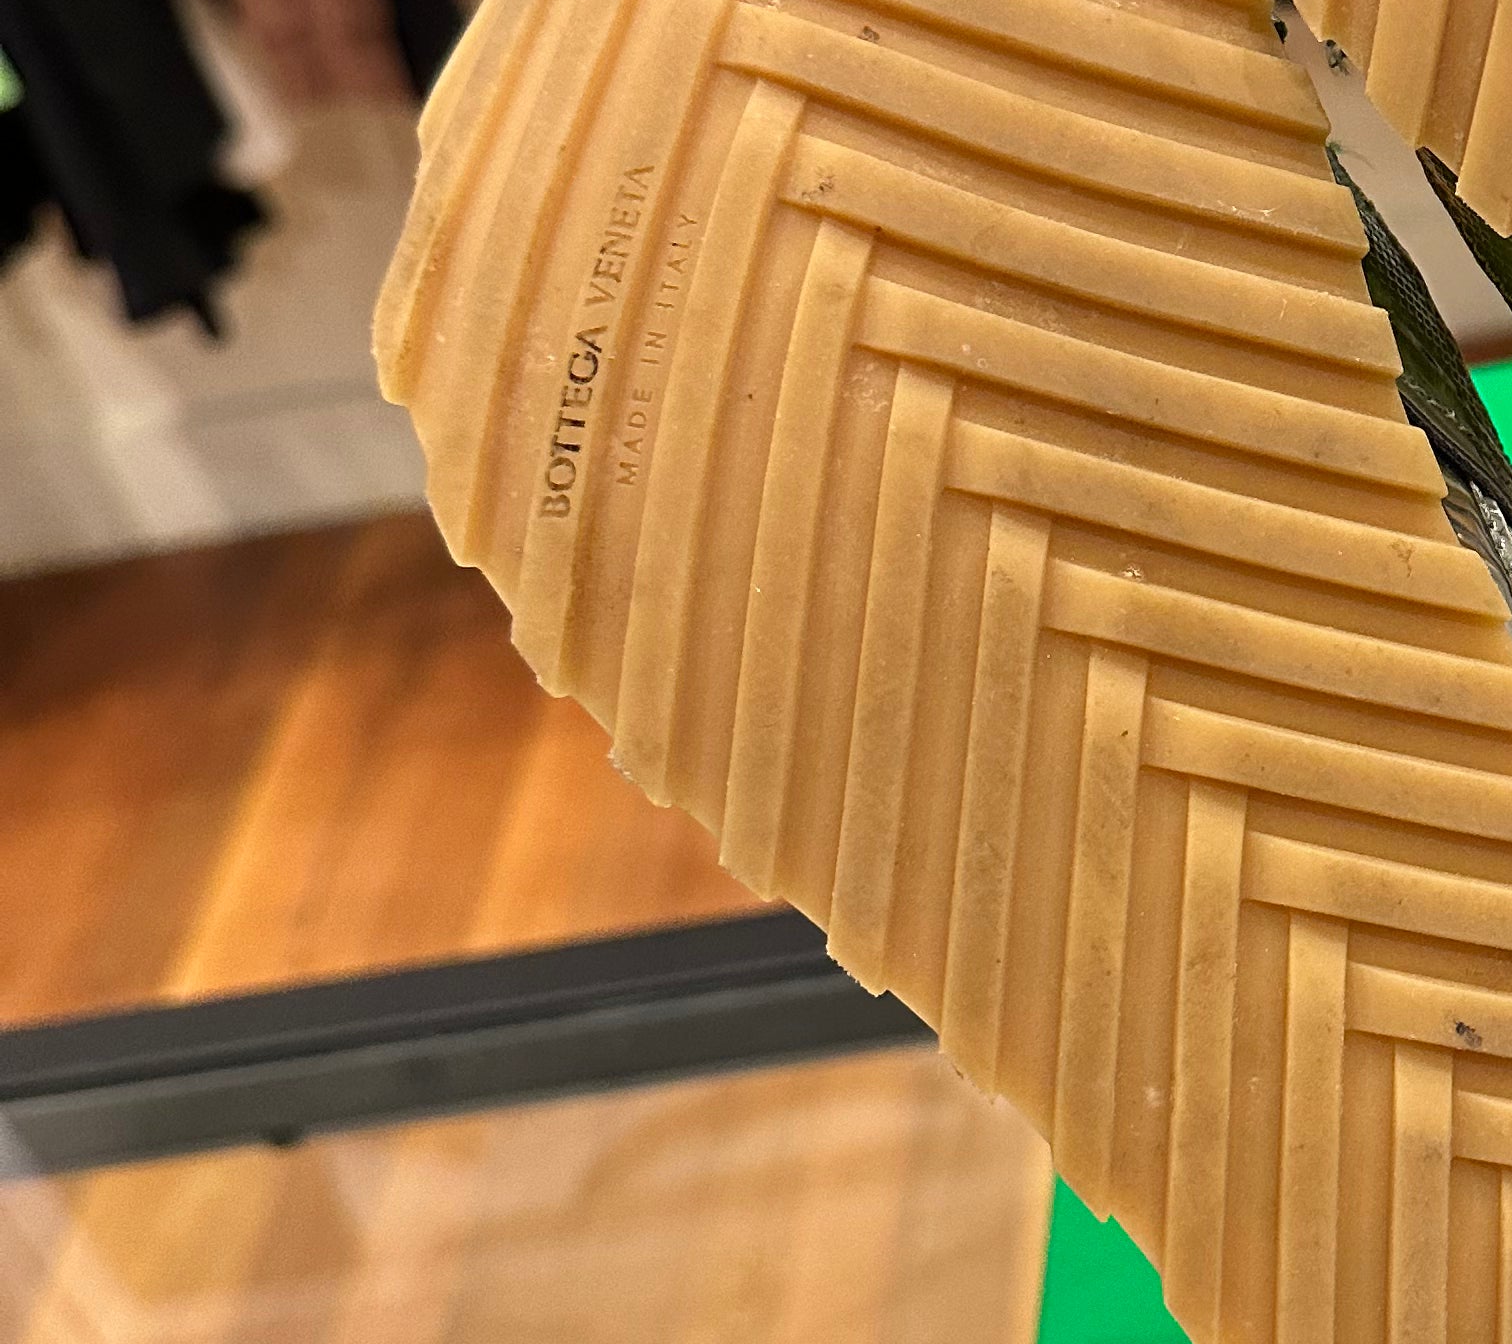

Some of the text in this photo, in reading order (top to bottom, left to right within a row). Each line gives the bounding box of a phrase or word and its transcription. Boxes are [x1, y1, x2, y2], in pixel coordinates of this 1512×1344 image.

[538, 164, 655, 519] BOTTEGA VENETA
[616, 212, 698, 487] MADE IN ITALY
